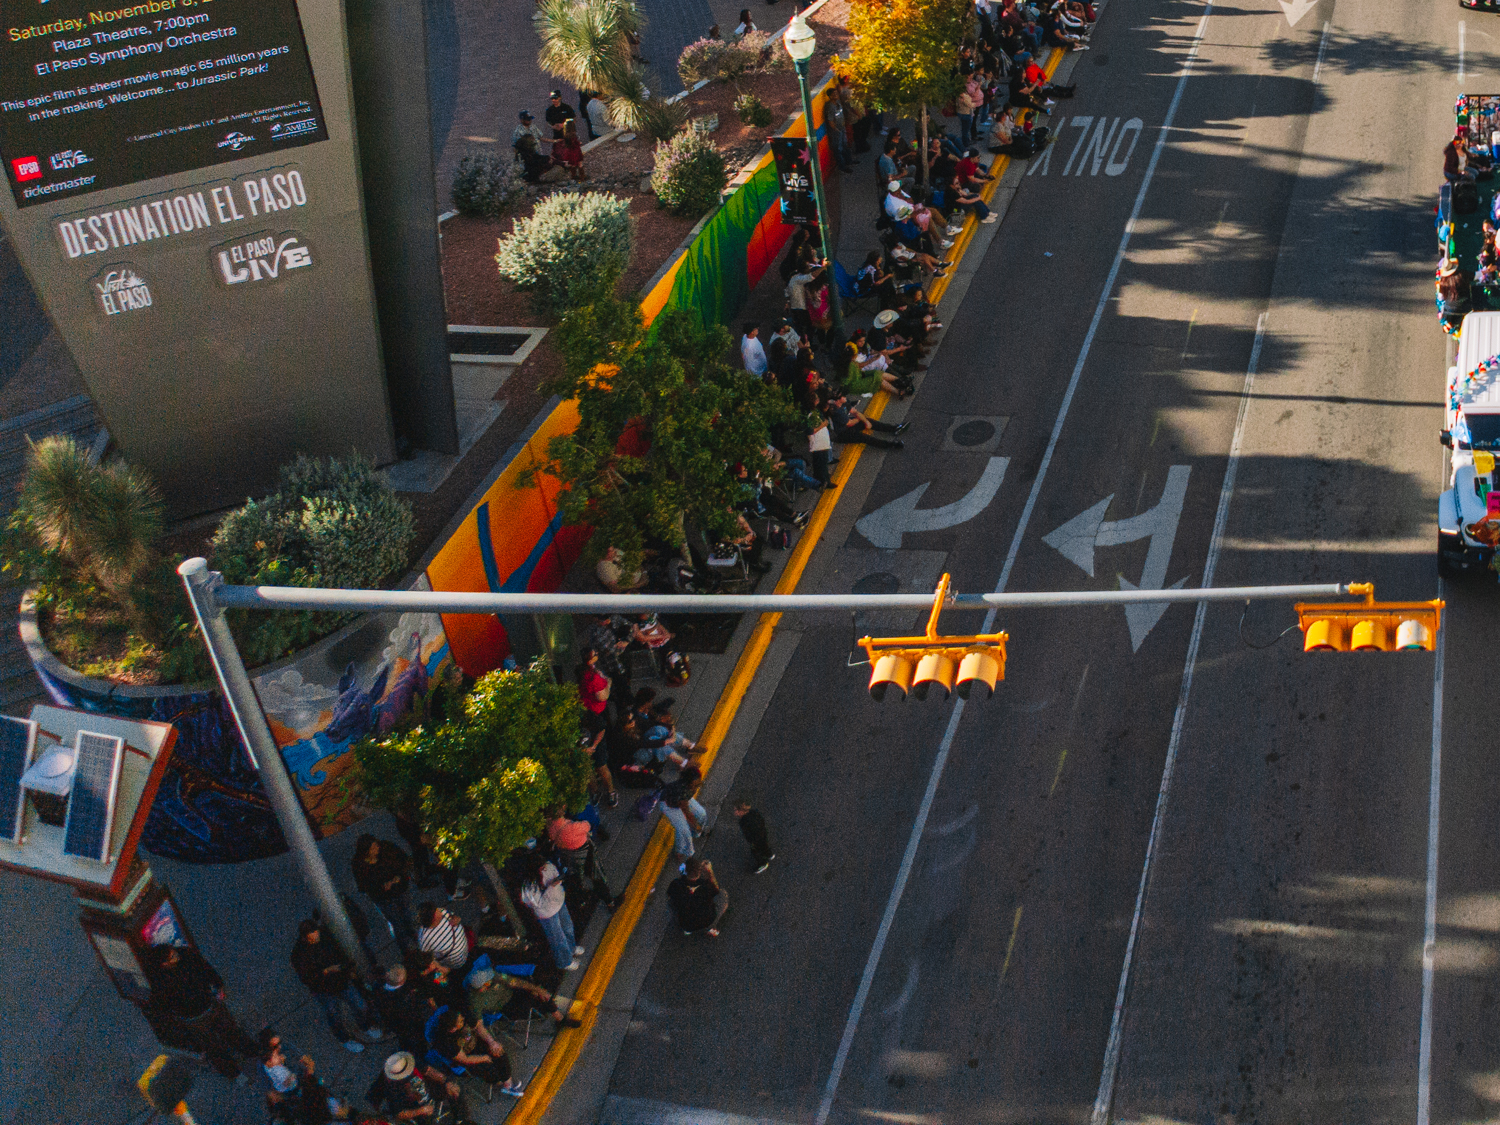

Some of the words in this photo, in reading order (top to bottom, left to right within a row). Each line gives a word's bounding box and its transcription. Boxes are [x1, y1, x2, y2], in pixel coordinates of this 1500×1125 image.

[8, 17, 87, 42] Saturday,
[52, 37, 92, 53] Plaza
[93, 26, 152, 45] Theatre,
[154, 12, 210, 32] 7:00pm
[35, 63, 51, 76] El
[51, 56, 88, 73] Paso
[89, 41, 164, 65] Symphony
[165, 26, 237, 48] Orchestra
[1, 101, 26, 112] This
[26, 93, 51, 109] epic
[52, 89, 76, 102] film
[77, 86, 88, 97] is
[90, 78, 122, 94] sheer
[123, 71, 160, 86] movie
[160, 64, 197, 81] magic
[198, 59, 214, 70] 65
[215, 51, 256, 67] million
[256, 45, 290, 62] years
[27, 112, 41, 123] in
[41, 106, 61, 120] the
[62, 98, 108, 117] making.
[108, 85, 175, 105] Welcome...
[176, 78, 190, 90] to
[190, 69, 237, 88] Jurassic
[238, 63, 269, 77] Park!
[201, 118, 216, 127] LLC
[217, 115, 229, 124] and
[251, 116, 262, 124] All
[217, 135, 256, 148] UNIVERSAL
[18, 161, 40, 176] EPSO
[50, 149, 88, 170] LIVE
[23, 175, 96, 198] ticketmaster
[59, 192, 212, 259] DESTINATION
[211, 185, 244, 224] EL
[243, 170, 307, 216] PASO
[218, 238, 312, 285] LIVE
[232, 245, 246, 263] EL
[246, 236, 276, 259] PASO
[101, 292, 120, 316] EL
[119, 285, 152, 312] PASO
